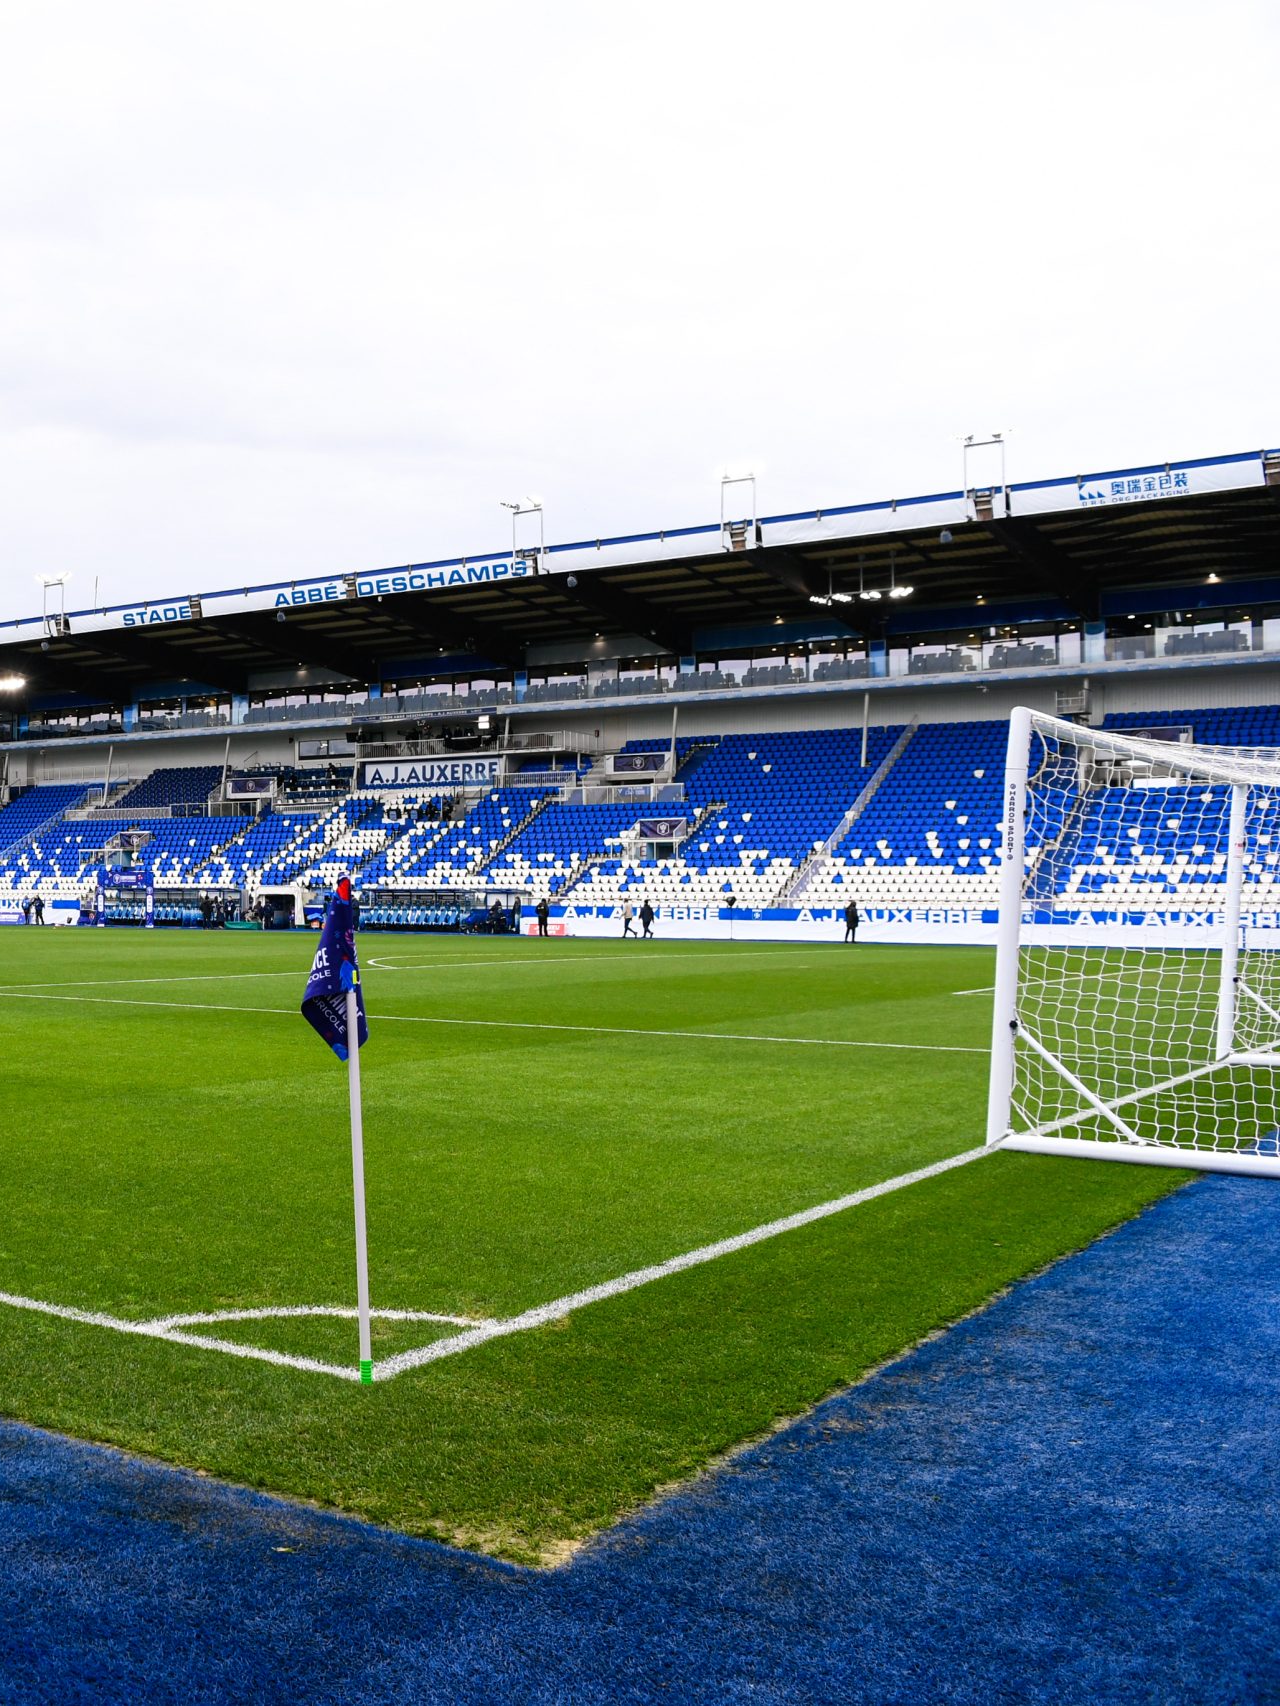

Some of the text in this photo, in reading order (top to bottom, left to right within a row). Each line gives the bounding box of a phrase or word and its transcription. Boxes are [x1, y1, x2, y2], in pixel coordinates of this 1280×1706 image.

[1111, 472, 1189, 496] 奥瑞金包装
[1134, 488, 1190, 500] PACKAGING
[122, 605, 193, 627] STADE
[857, 909, 983, 923] AUXERRE
[1140, 912, 1280, 928] AUXERR
